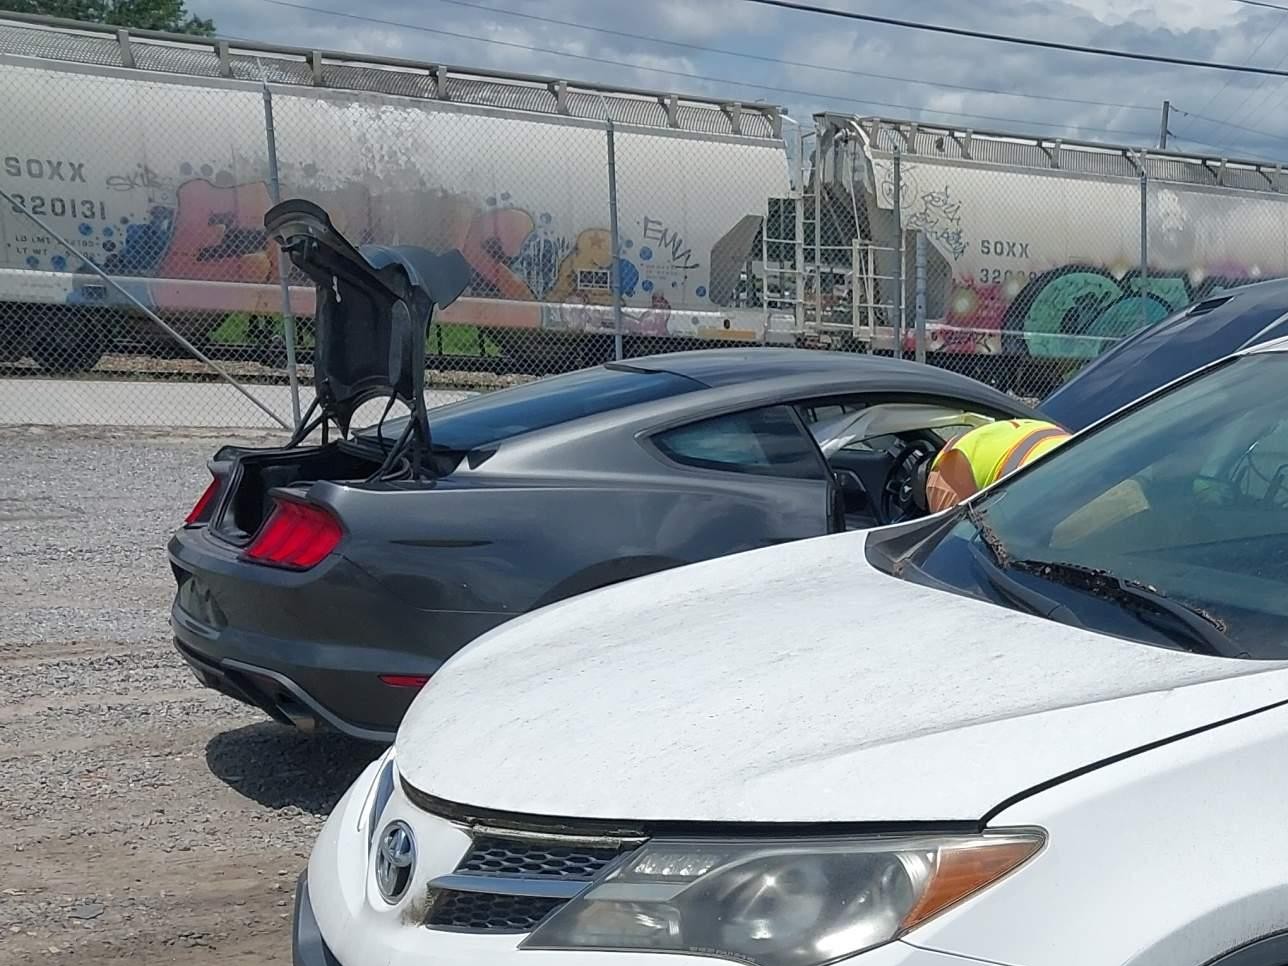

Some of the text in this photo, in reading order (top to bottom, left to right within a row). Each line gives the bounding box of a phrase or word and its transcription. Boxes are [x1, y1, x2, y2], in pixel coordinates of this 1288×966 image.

[4, 156, 87, 183] SOXX
[10, 193, 107, 221] 320131
[980, 239, 1030, 259] SOXX
